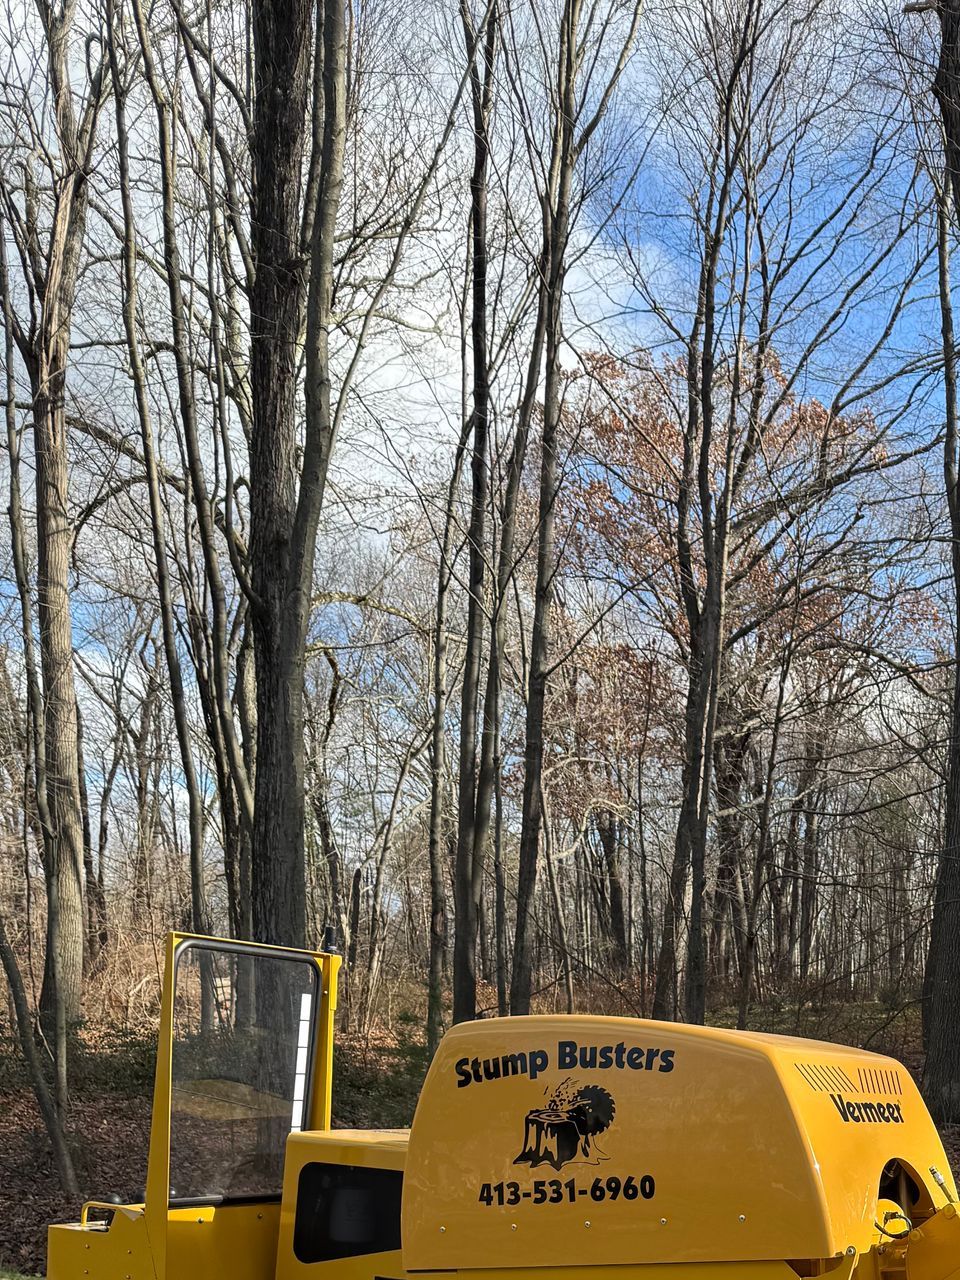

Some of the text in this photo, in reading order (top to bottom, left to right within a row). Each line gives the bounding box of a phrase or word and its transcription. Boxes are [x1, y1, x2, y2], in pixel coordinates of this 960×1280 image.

[455, 1040, 675, 1088] Stump Busters
[829, 1093, 904, 1123] Vermeer
[478, 1174, 656, 1207] 413-531-6960
